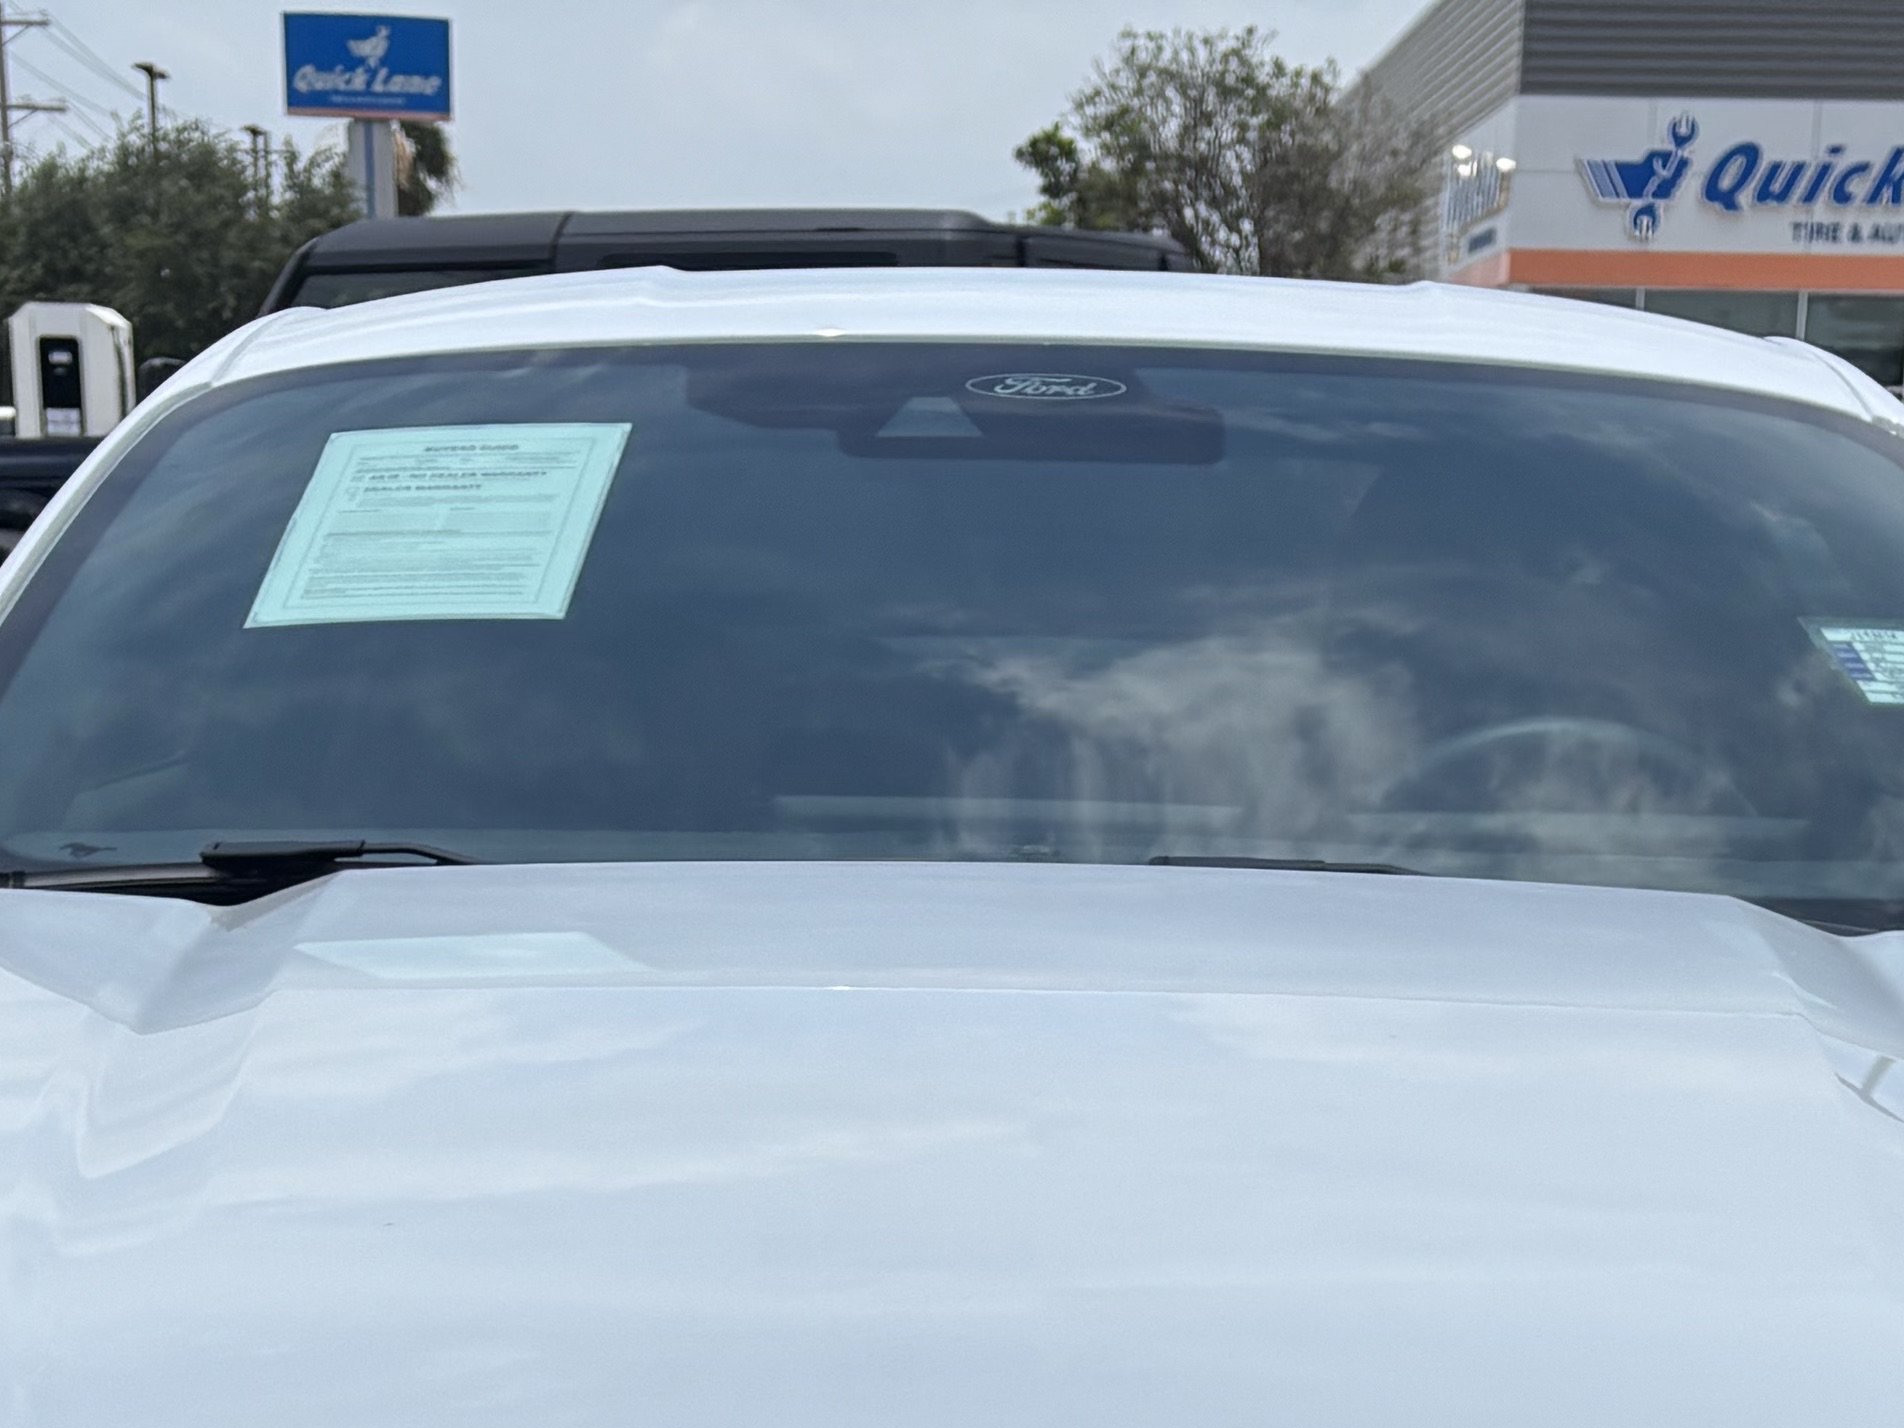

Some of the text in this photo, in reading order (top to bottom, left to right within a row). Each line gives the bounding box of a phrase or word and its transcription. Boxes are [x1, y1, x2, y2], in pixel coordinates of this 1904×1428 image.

[293, 64, 442, 95] Quick Lane
[1791, 221, 1841, 244] TIRE
[994, 376, 1097, 396] Ford
